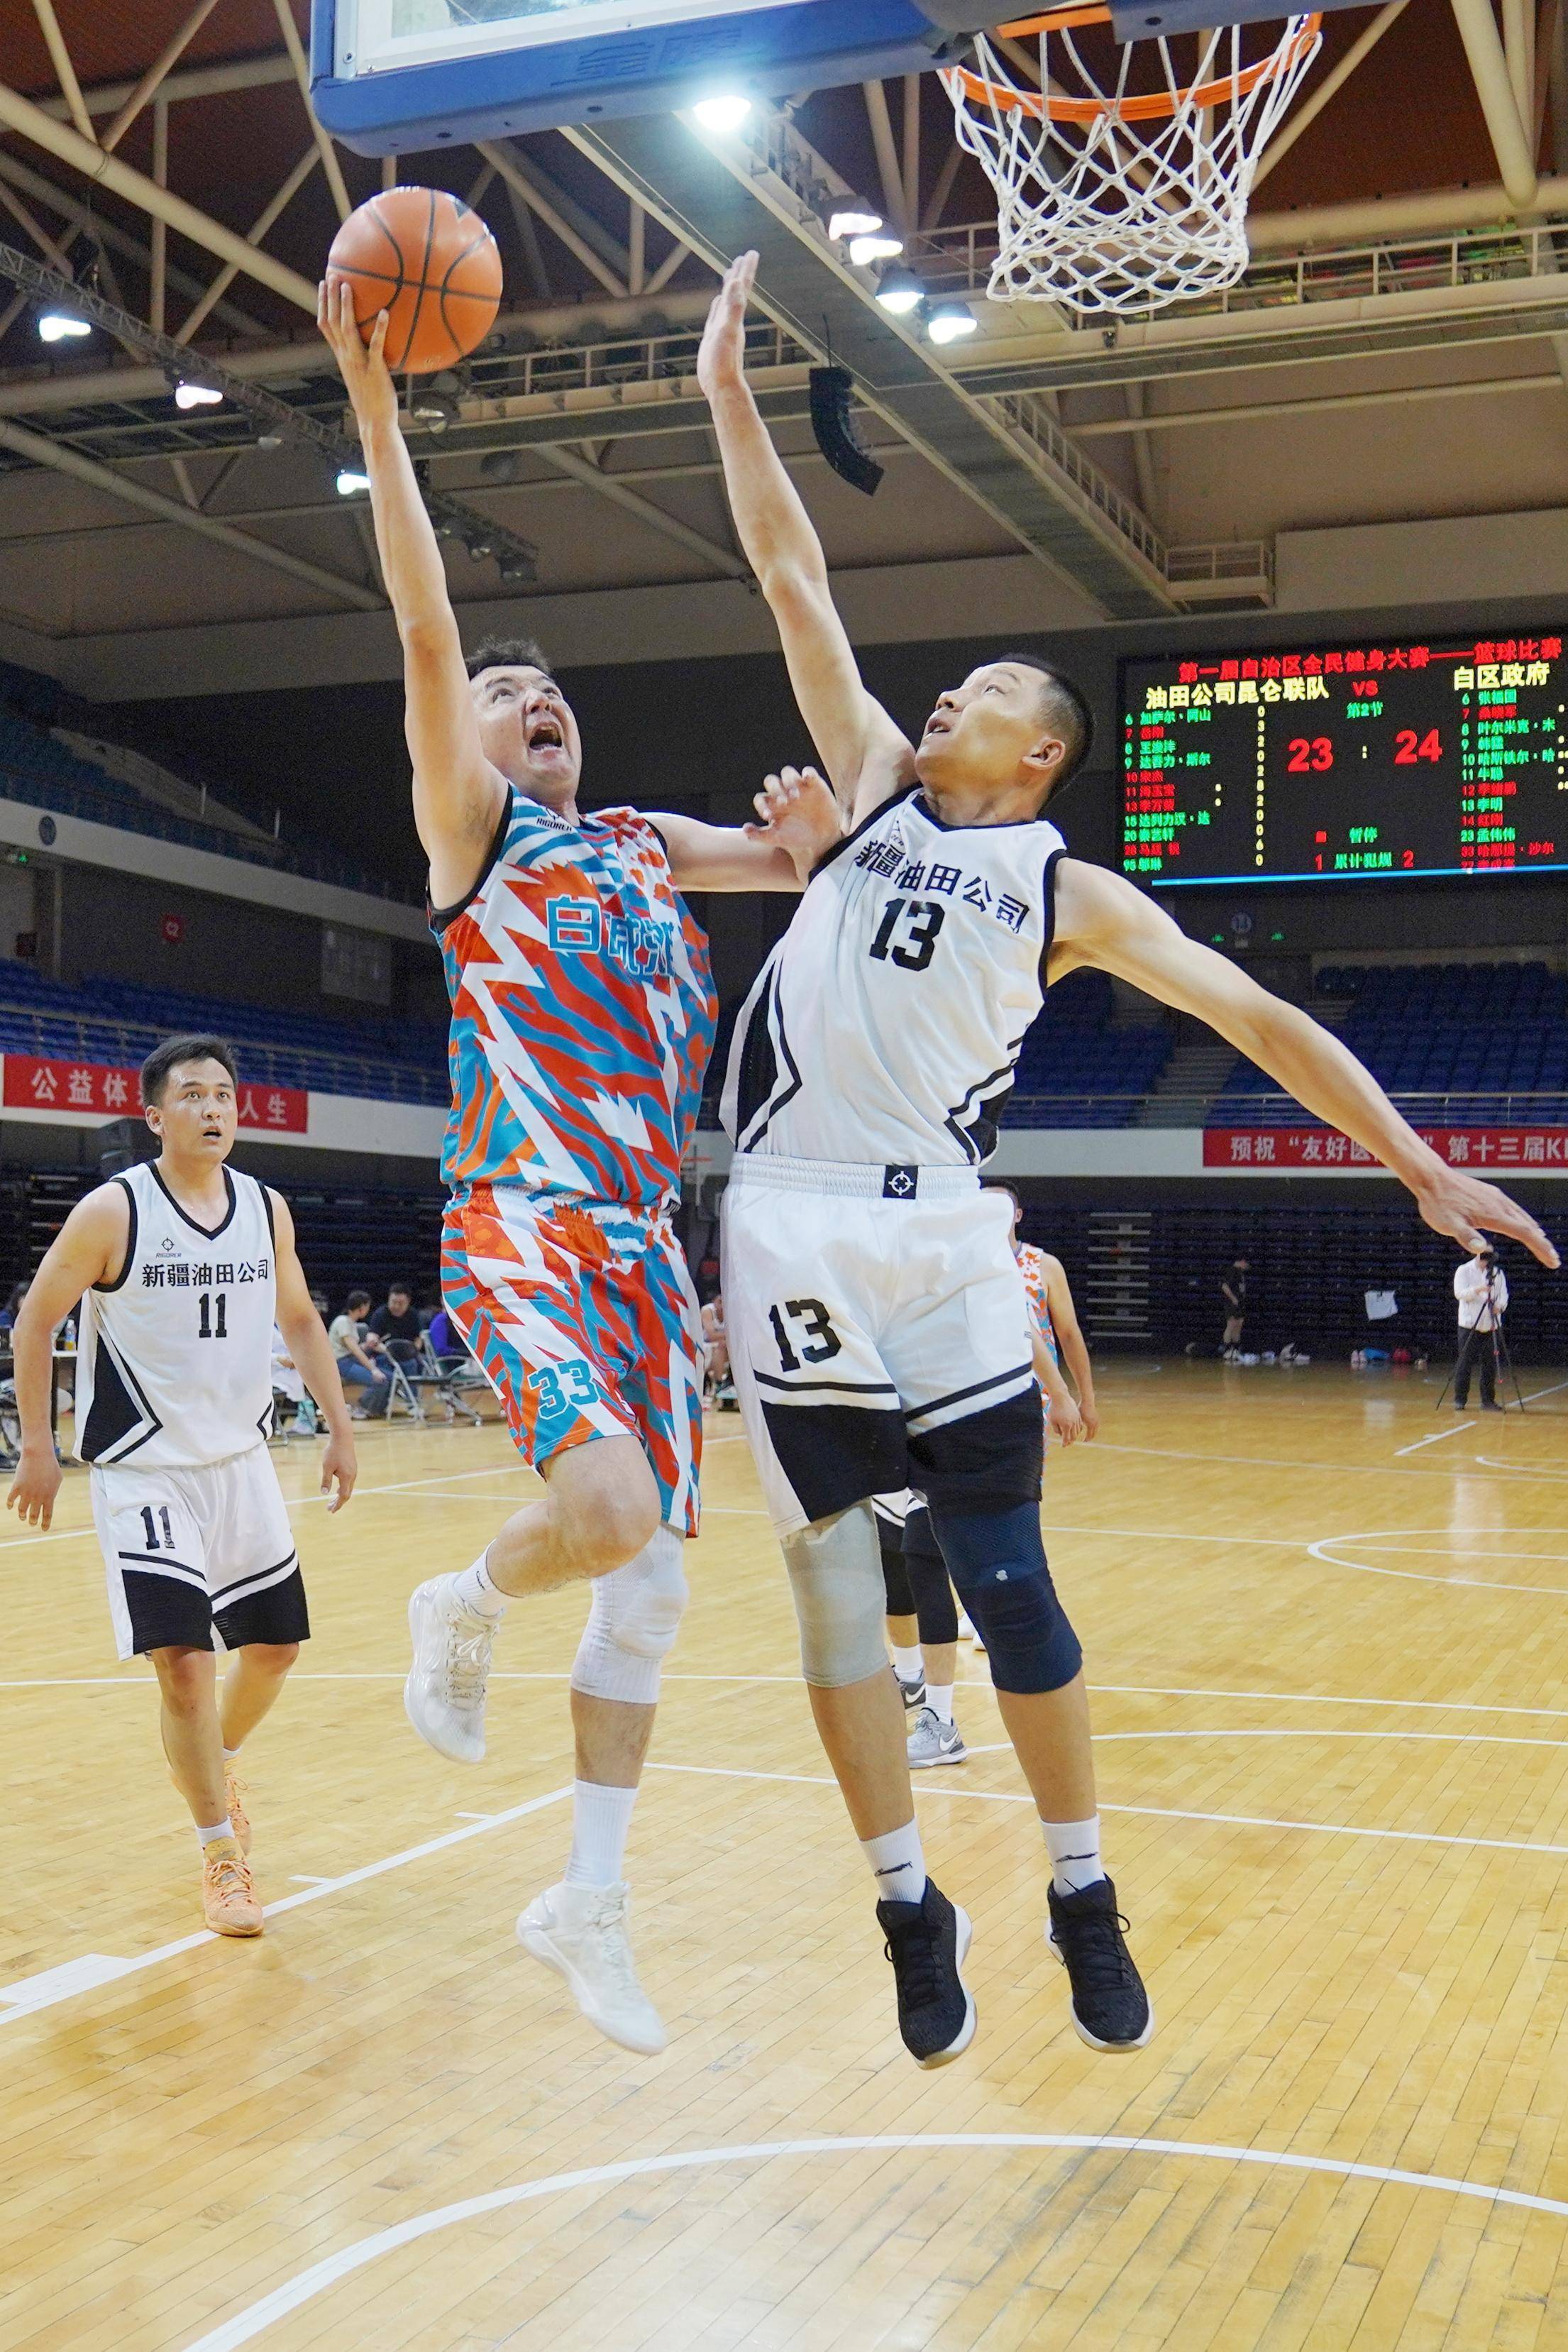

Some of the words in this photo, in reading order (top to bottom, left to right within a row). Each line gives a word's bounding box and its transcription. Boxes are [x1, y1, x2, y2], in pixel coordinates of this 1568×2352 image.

[1455, 661, 1550, 691] 白区政府
[1147, 676, 1330, 709] 油田公司昆仑联队
[1353, 681, 1379, 697] VS
[1463, 694, 1470, 705] 6
[1259, 707, 1265, 718] 0
[1464, 709, 1470, 719] 7
[1259, 736, 1264, 747] 2
[1462, 740, 1469, 752] 9
[1258, 752, 1265, 762] 0
[1288, 738, 1334, 773] 23
[1396, 730, 1443, 764] 24
[1464, 754, 1476, 766] 10
[1259, 766, 1264, 776] 2
[1463, 769, 1474, 781] 11
[1463, 786, 1476, 797] 12
[1127, 802, 1137, 813] 13
[1258, 796, 1264, 807] 2
[1257, 810, 1264, 821] 0
[1463, 817, 1475, 825] 14
[1257, 825, 1264, 836] 0
[1257, 855, 1264, 866] 0
[1316, 855, 1323, 871] 1
[1404, 851, 1414, 868] 2
[869, 897, 945, 972] 13
[31, 1066, 145, 1109] 公益体
[239, 1096, 288, 1124] 人生
[142, 1259, 268, 1287] 新疆油田公司
[199, 1293, 227, 1339] 11
[768, 1298, 842, 1373] 13
[527, 1358, 601, 1420] 33
[140, 1505, 176, 1551] 11
